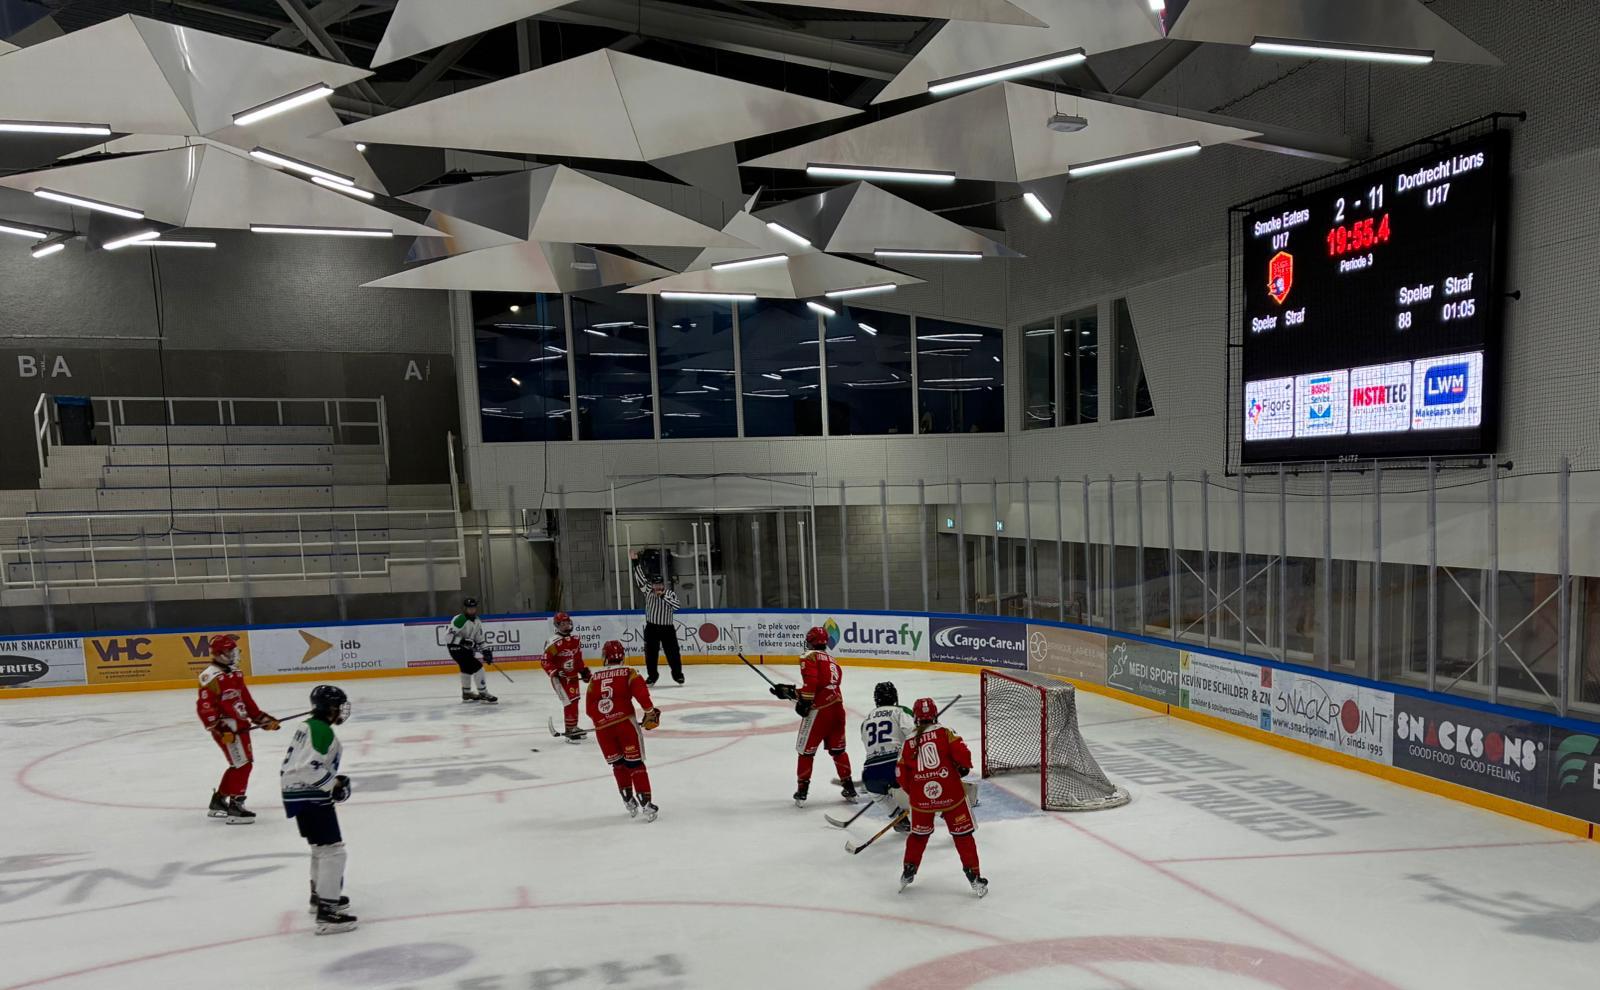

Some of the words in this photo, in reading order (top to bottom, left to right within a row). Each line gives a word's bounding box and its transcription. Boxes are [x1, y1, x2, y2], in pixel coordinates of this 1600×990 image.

[1398, 159, 1451, 191] Dordrecht
[1452, 151, 1485, 175] Lions
[1335, 197, 1345, 221] 2
[1368, 183, 1384, 210] 11
[1426, 183, 1451, 206] U17
[1254, 216, 1282, 236] Smoke
[1282, 208, 1310, 228] Eaters
[1272, 231, 1290, 250] U17
[1327, 212, 1391, 256] 19:55.4
[1340, 256, 1367, 273] Periode
[1367, 252, 1374, 267] 3
[1399, 283, 1435, 305] Speler
[1444, 272, 1474, 295] Straf
[1251, 314, 1278, 333] Speler
[1284, 306, 1306, 326] Straf
[1397, 311, 1412, 330] 88
[1442, 298, 1476, 321] 01:05
[17, 355, 38, 377] B
[51, 355, 73, 378] A
[404, 360, 423, 380] A
[1310, 383, 1331, 396] BOSCH
[1352, 383, 1408, 407] INSTATEC
[1428, 373, 1465, 396] LWM
[1262, 398, 1291, 417] Figors
[1415, 408, 1452, 418] Makelaars
[1452, 407, 1466, 415] van
[575, 624, 591, 632] dan
[757, 623, 767, 631] De
[768, 623, 783, 634] plek
[776, 631, 791, 639] dan
[842, 621, 923, 652] durafy
[0, 642, 18, 652] VAN
[21, 638, 80, 651] SNACKPOINT
[92, 637, 154, 662] VHC
[340, 639, 362, 650] idb
[706, 643, 727, 652] sinds
[758, 639, 783, 648] lekkere
[953, 633, 1026, 652] Cargo-Care.nl
[340, 651, 358, 661] job
[341, 659, 383, 671] support
[0, 662, 43, 674] FRITES
[1128, 660, 1149, 679] MEDI
[1149, 668, 1179, 687] SPORT
[600, 678, 614, 699] 5
[1181, 672, 1202, 689] KEVIN
[1202, 678, 1212, 692] DE
[1213, 680, 1249, 701] SCHILDER
[1251, 689, 1259, 703] &
[1259, 691, 1271, 707] ZN
[865, 719, 893, 747] 32
[1272, 717, 1337, 742] www.snackpoint.nl
[917, 741, 941, 773] 10
[1346, 735, 1366, 750] sinds
[1367, 743, 1384, 757] 1995
[1408, 744, 1432, 761] GOOD
[1432, 749, 1455, 766] FOOD
[1459, 757, 1486, 775] GOOD
[1486, 763, 1521, 784] FEELING
